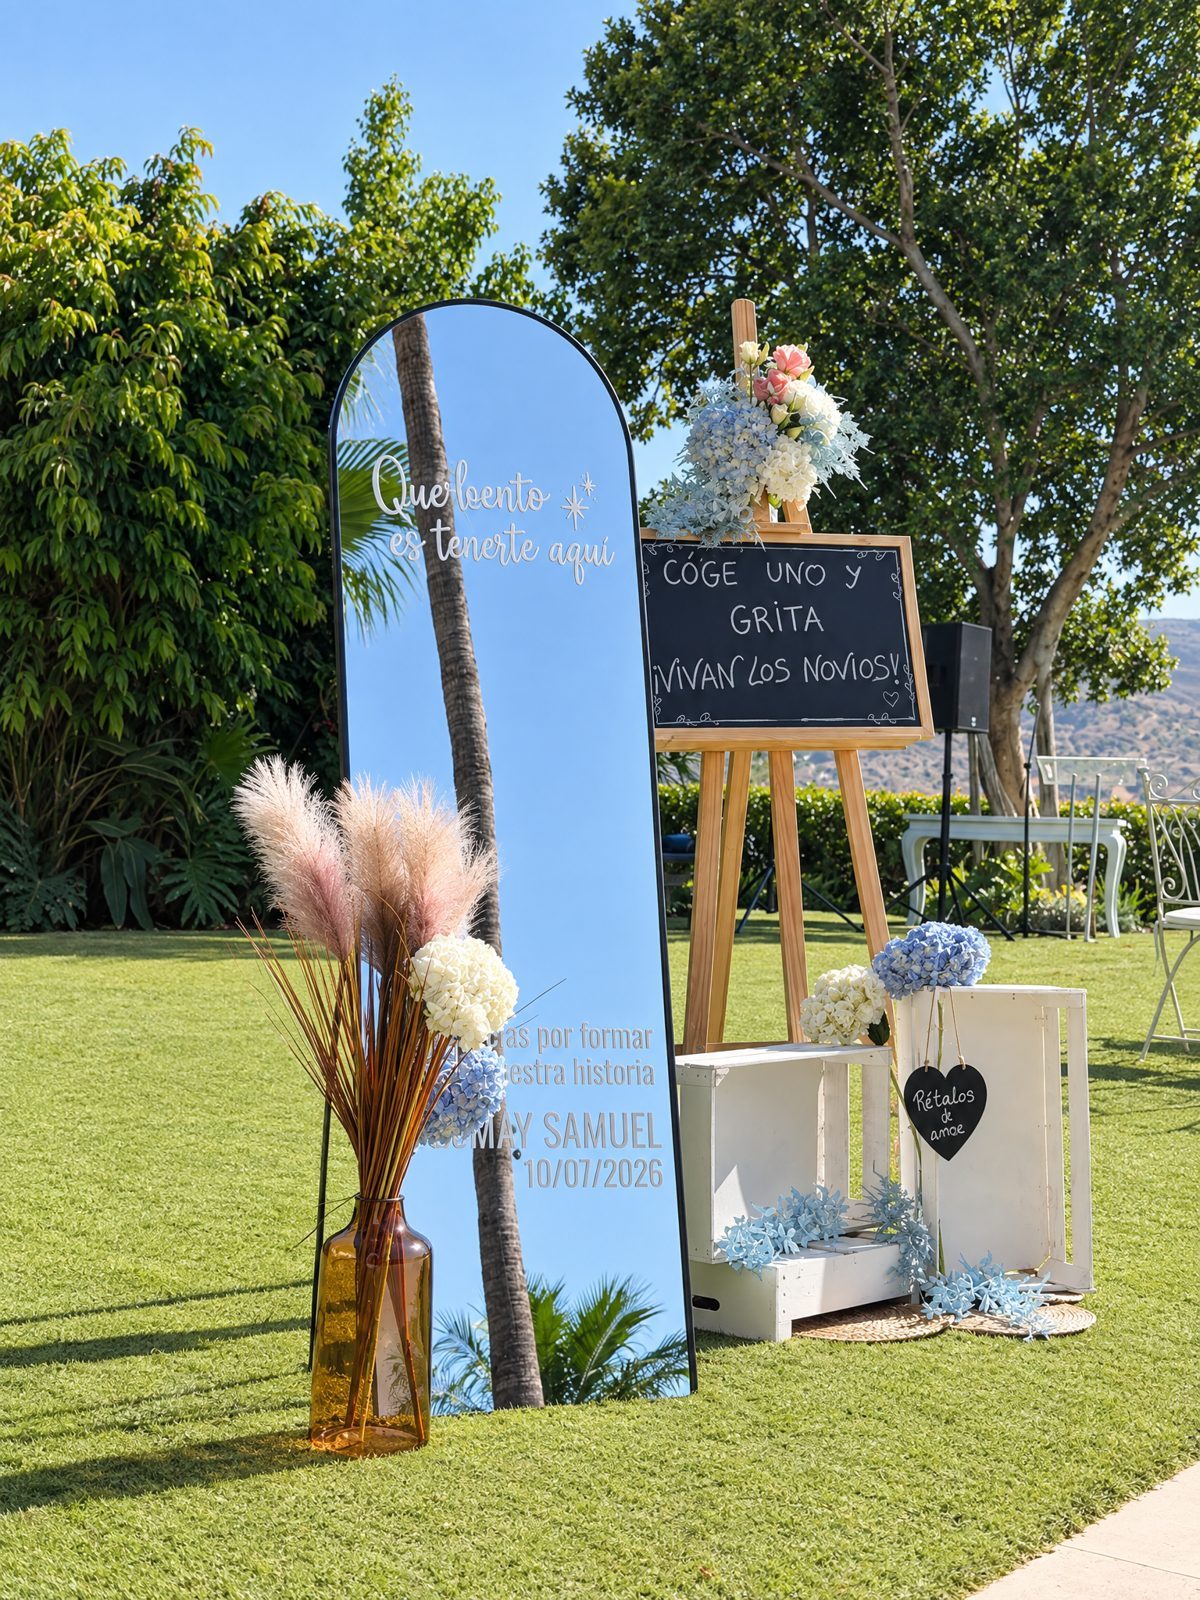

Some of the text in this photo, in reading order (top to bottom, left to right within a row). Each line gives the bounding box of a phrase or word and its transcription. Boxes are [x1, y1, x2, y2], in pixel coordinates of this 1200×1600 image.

[389, 518, 615, 586] es tenerte aquí
[766, 561, 826, 586] UNO
[537, 1026, 574, 1055] por
[579, 1021, 654, 1049] formar
[573, 1057, 656, 1086] historia
[543, 1111, 662, 1150] SAMUEL
[523, 1158, 664, 1189] 10/07/2026
